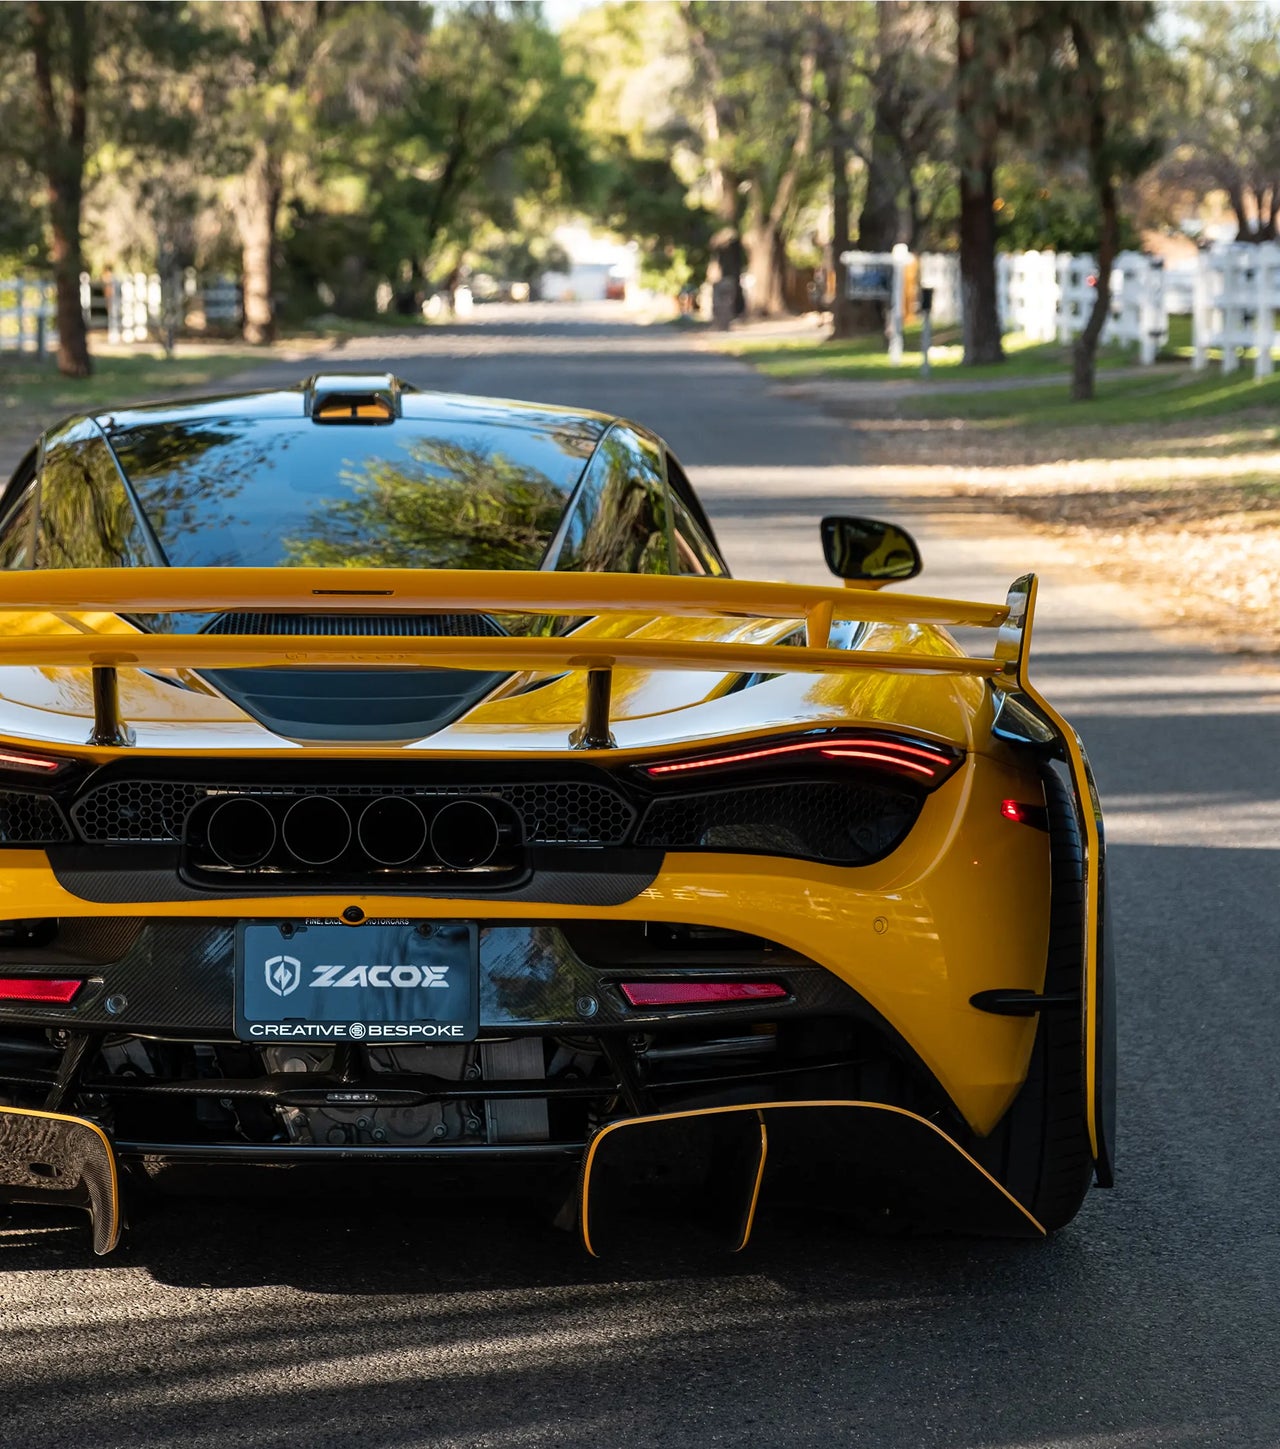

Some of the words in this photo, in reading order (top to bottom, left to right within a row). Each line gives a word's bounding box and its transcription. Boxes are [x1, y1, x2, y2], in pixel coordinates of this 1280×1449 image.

[309, 965, 450, 988] ZACOE
[250, 1024, 347, 1036] CREATIVE
[368, 1025, 464, 1037] BESPOKE
